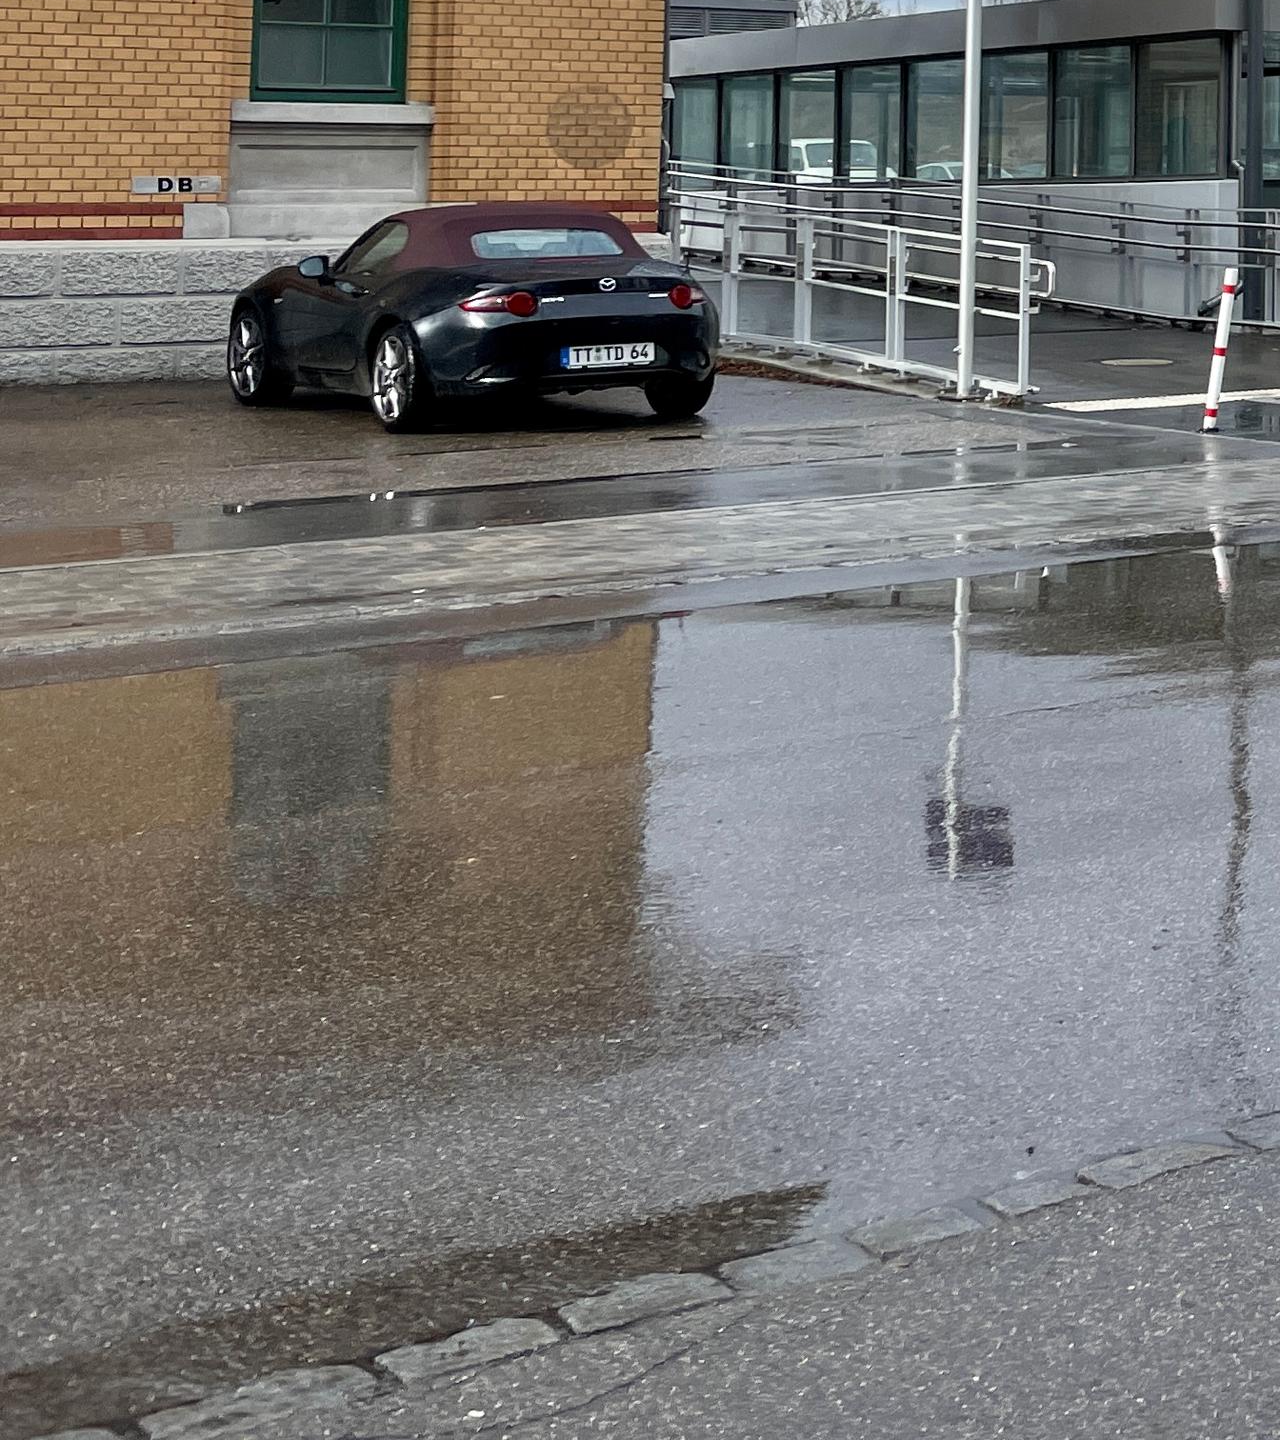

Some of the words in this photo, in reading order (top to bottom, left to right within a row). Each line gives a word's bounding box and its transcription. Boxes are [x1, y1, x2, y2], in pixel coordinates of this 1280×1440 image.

[572, 347, 593, 363] TT
[604, 346, 624, 361] TD
[630, 344, 649, 359] 64
